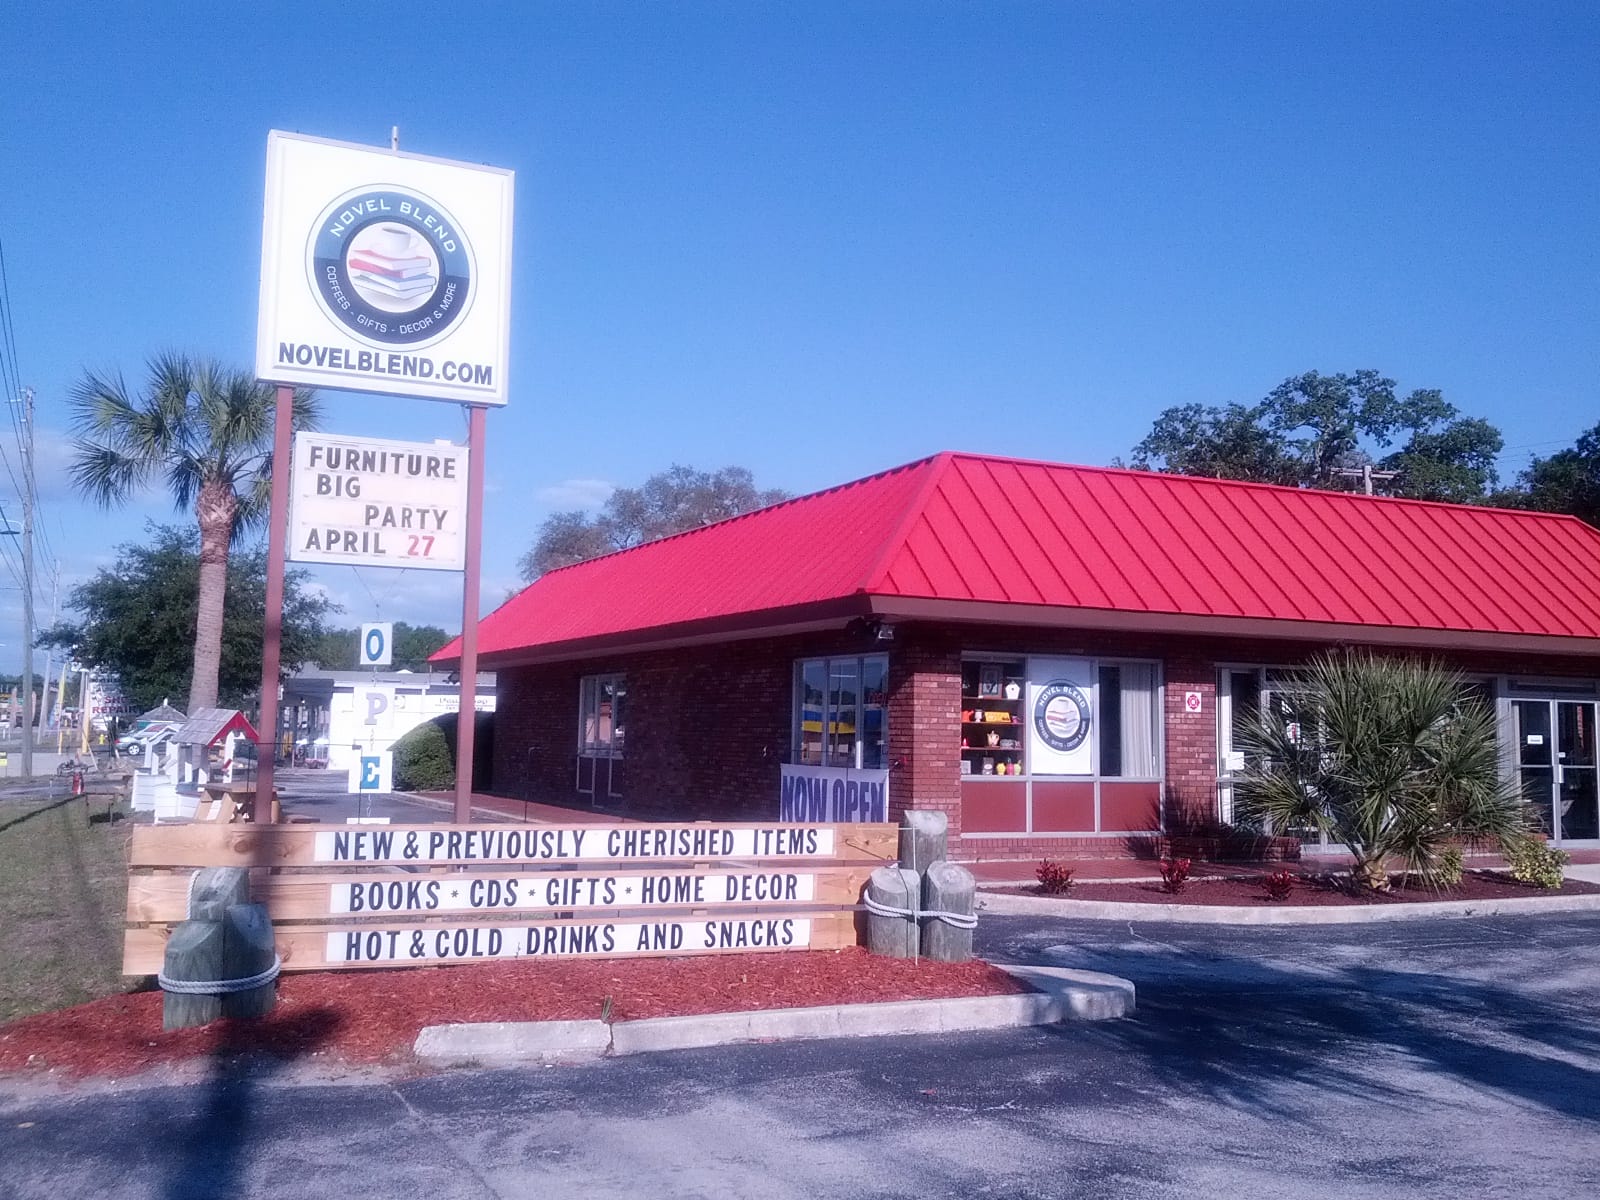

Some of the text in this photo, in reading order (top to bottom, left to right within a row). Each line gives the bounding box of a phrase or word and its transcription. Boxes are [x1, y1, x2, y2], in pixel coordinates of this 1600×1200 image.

[329, 198, 457, 252] NOVEL BLEND
[326, 265, 457, 335] COFFEES GIFTS DECOR & MORE
[278, 342, 493, 386] NOVELBLEND.COM
[309, 445, 456, 479] FURNITURE
[316, 473, 361, 498] BIG
[364, 504, 448, 530] PARTY
[305, 528, 435, 557] APRIL 27
[92, 705, 138, 714] REPAIR
[782, 775, 828, 823] NOW
[333, 828, 818, 861] NEW & PREVIOUSLY CHERISHED ITEMS
[350, 873, 798, 912] BOOKS CDS GIFTS HOME DECOR
[345, 918, 794, 961] HOT & COLD DRINKS AND SNACKS
